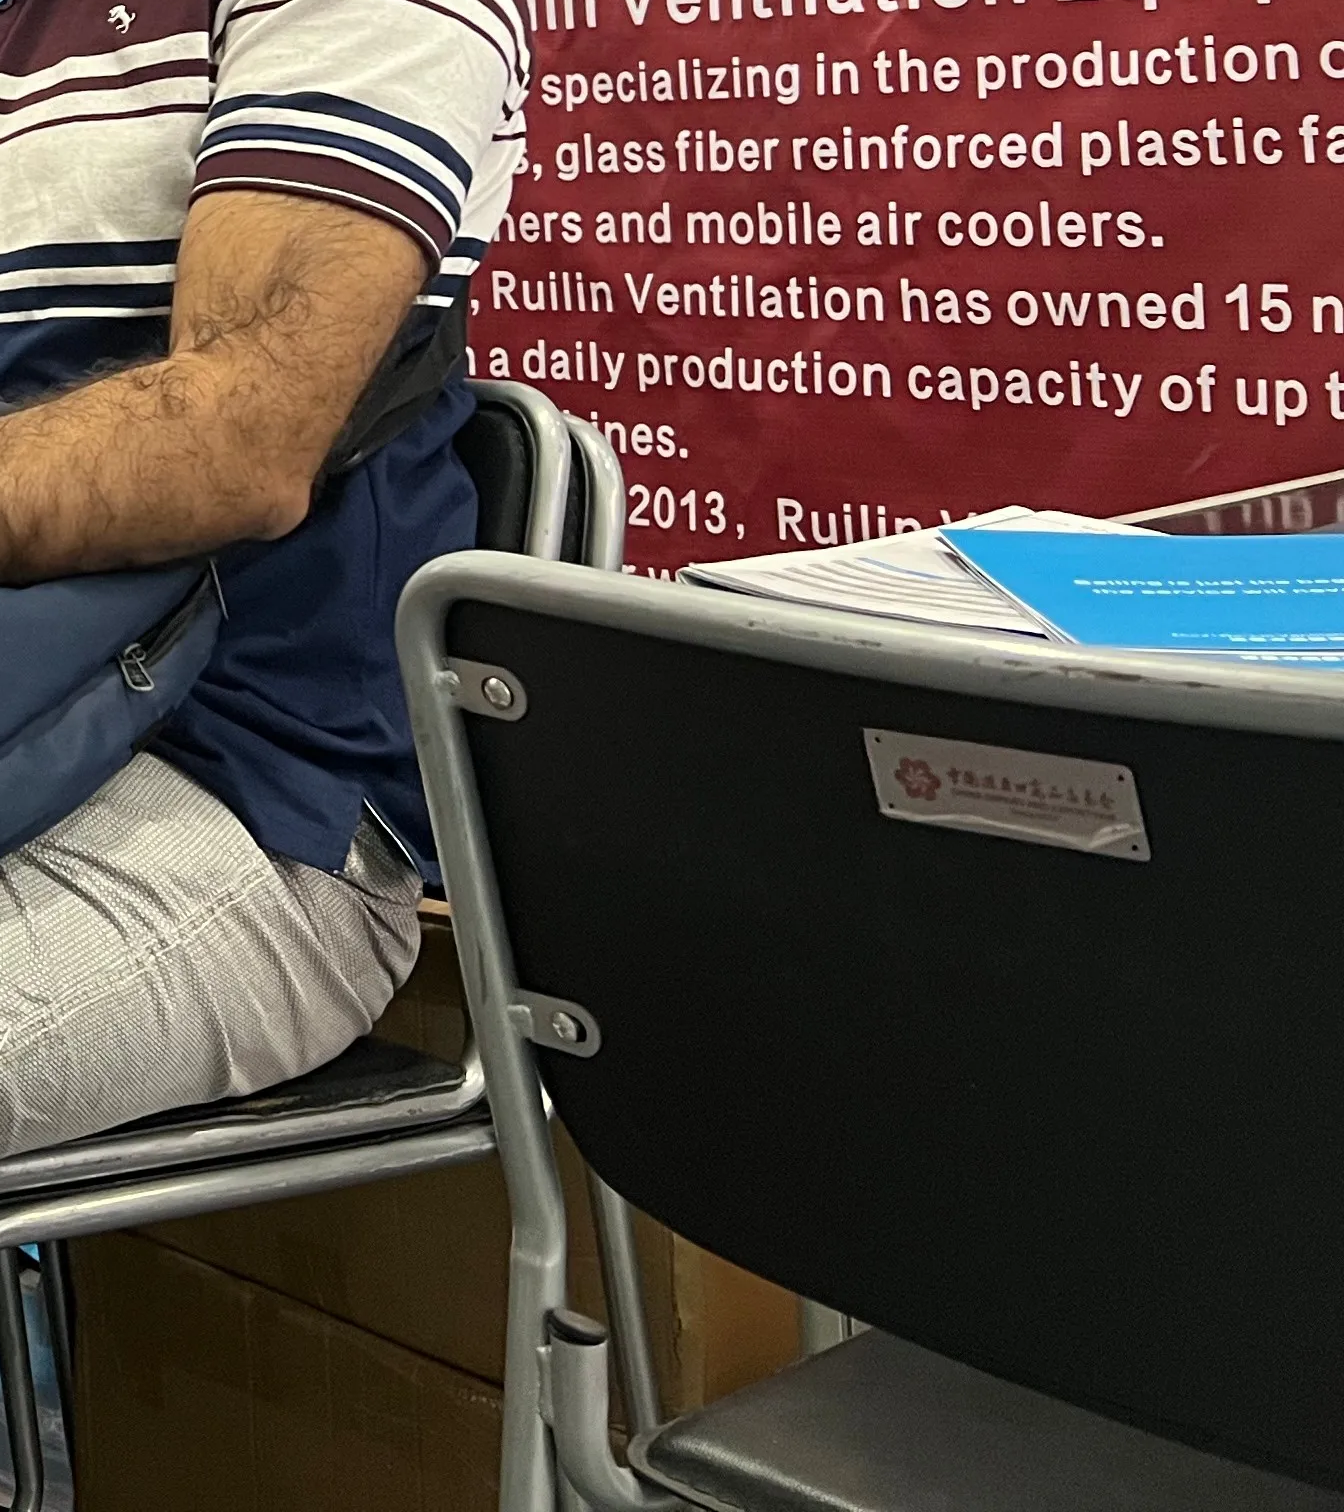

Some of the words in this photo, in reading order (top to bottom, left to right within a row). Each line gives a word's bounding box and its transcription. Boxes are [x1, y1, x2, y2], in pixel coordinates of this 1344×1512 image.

[540, 55, 800, 112] specializing
[815, 51, 861, 93] in
[874, 47, 961, 94] the
[976, 36, 1301, 100] production
[556, 128, 665, 183] glass
[675, 127, 778, 173] fiber
[792, 121, 1064, 172] reinforced
[1080, 116, 1284, 177] plastic
[594, 202, 672, 245] and
[685, 200, 842, 247] mobile
[856, 202, 924, 247] air
[937, 200, 1165, 249] coolers.
[491, 271, 616, 313] Ruilin
[624, 272, 886, 322] Ventilation
[900, 279, 992, 326] has
[1008, 282, 1207, 333] owned
[1224, 283, 1290, 334] 15
[488, 345, 511, 378] a
[522, 339, 623, 392] daily
[636, 348, 893, 399] production
[906, 363, 1144, 417] capacity
[1159, 364, 1217, 415] of
[1235, 377, 1309, 427] up
[628, 483, 746, 541] 2013,
